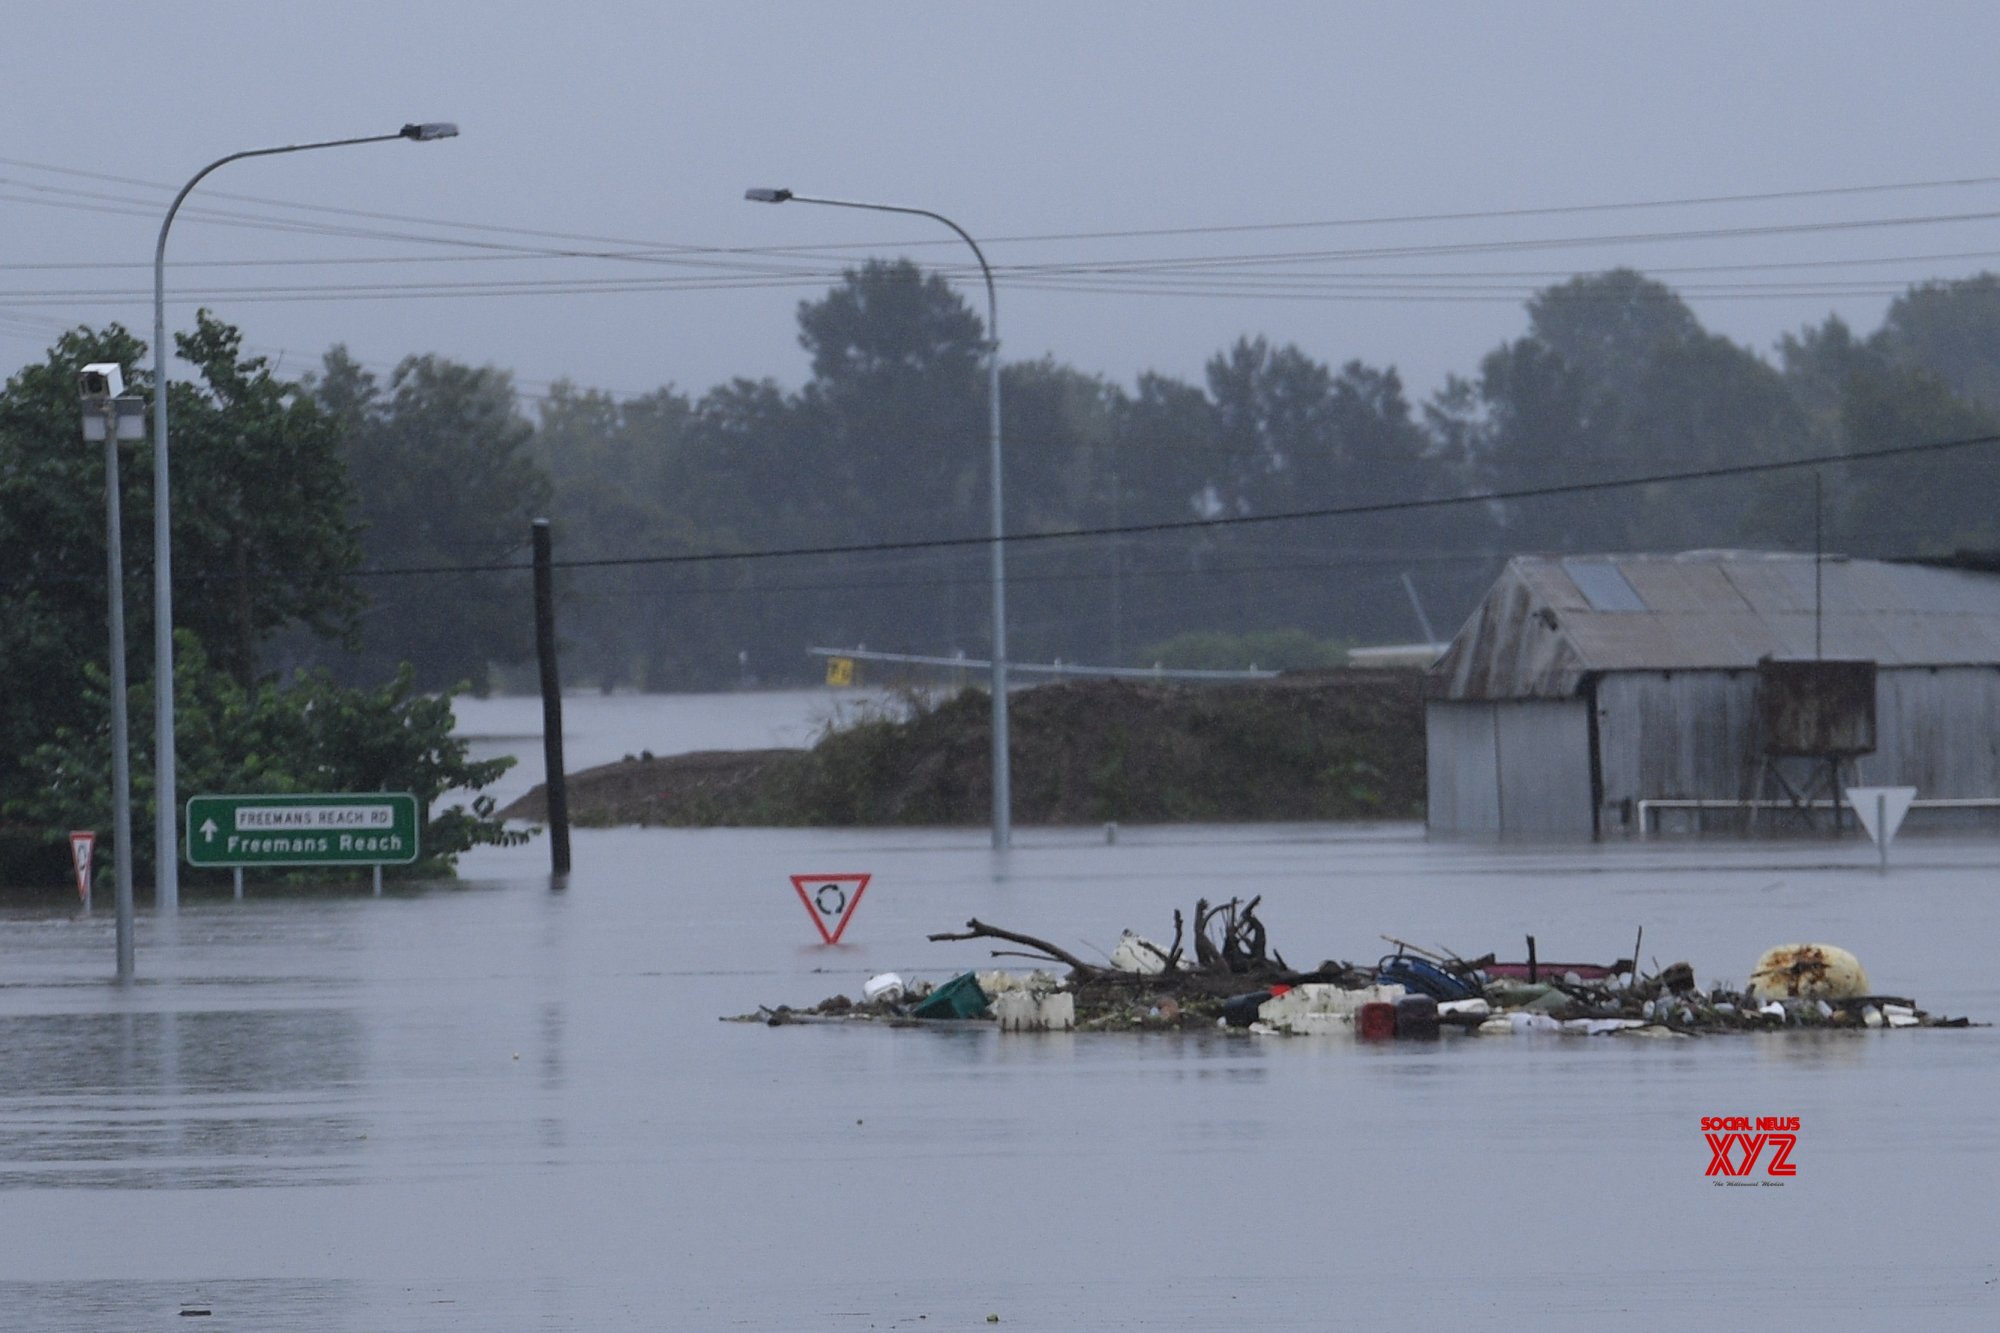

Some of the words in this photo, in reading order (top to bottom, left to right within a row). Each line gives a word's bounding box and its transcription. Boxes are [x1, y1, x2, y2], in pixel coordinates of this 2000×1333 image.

[239, 812, 312, 825] FREEMANS
[318, 811, 364, 824] REACH
[371, 811, 387, 823] RD
[227, 836, 328, 853] Freemans
[340, 834, 402, 851] Reach
